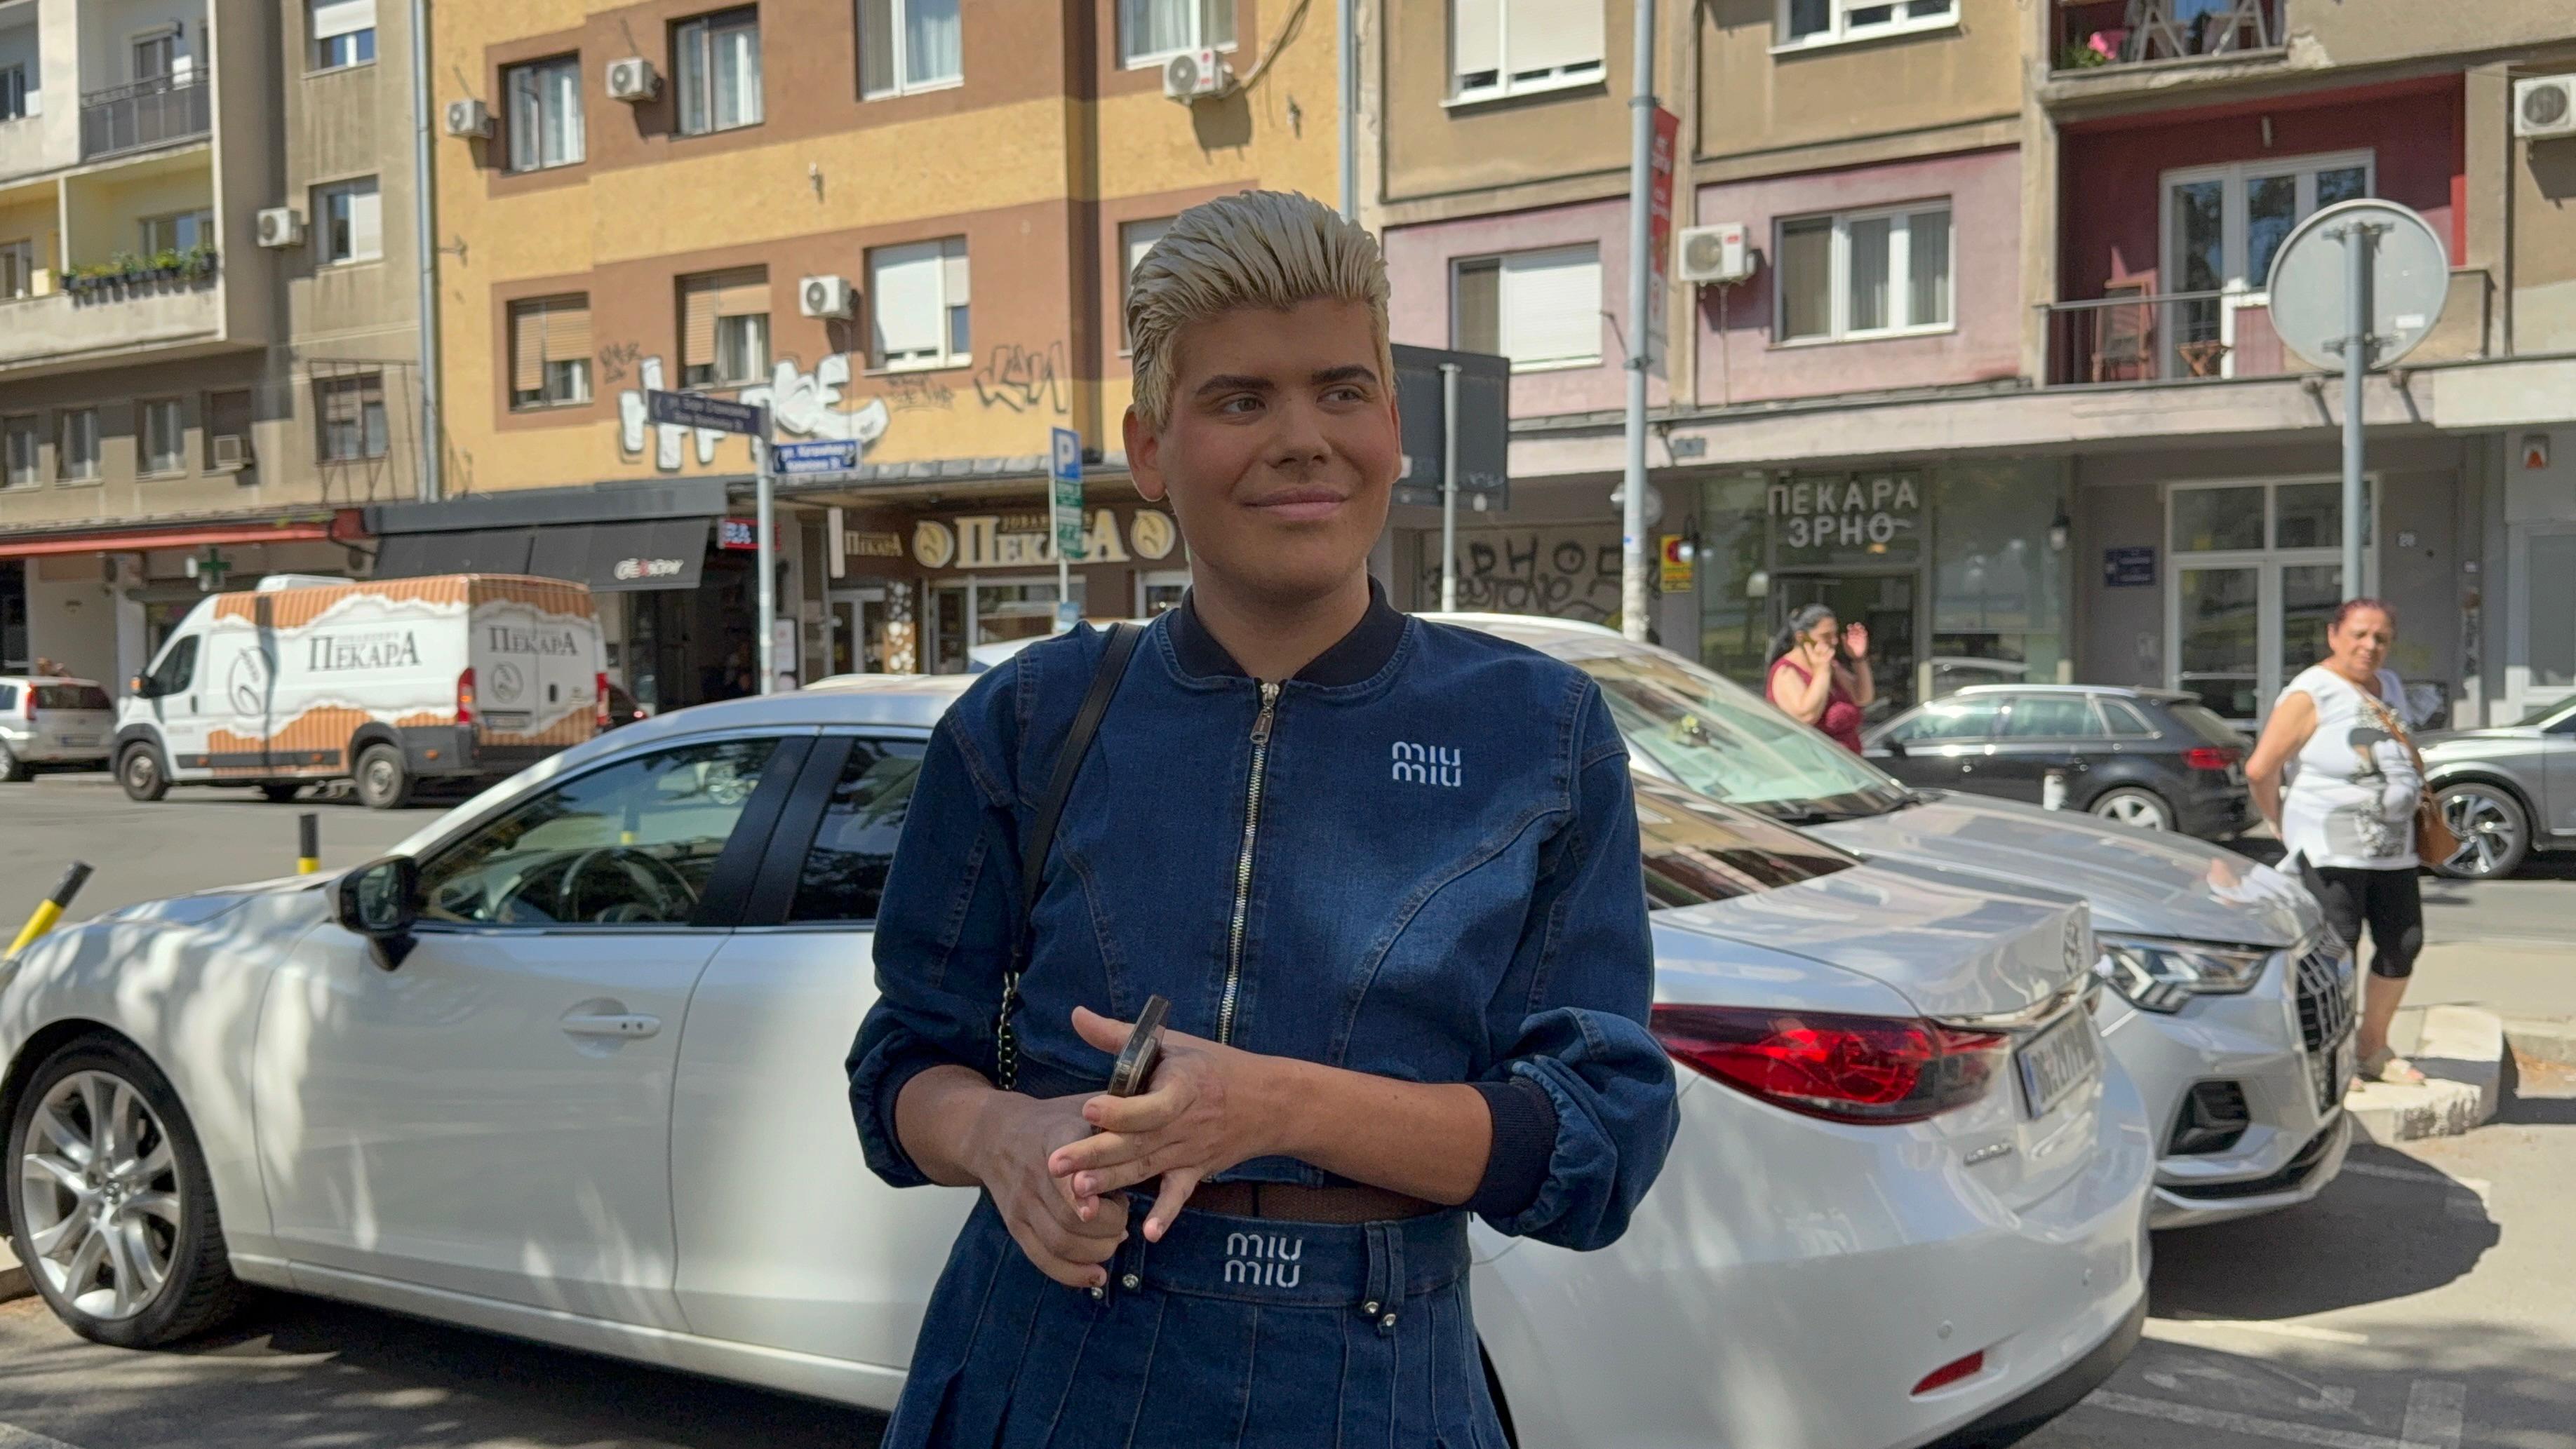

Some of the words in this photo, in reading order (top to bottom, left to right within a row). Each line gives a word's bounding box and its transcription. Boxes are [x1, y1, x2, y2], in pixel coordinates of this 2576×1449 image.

[1056, 433, 1075, 475] P
[1767, 478, 1919, 516] ПЕКАРА
[955, 508, 1131, 569] ПЕКА
[1788, 511, 1895, 548] ЗРНО
[307, 628, 423, 673] ПЕКАРА
[488, 625, 579, 656] ПЕКАРА
[1392, 741, 1461, 767] miu
[1392, 761, 1462, 787] miu
[1227, 1232, 1303, 1261] miu
[1224, 1259, 1301, 1288] miu
